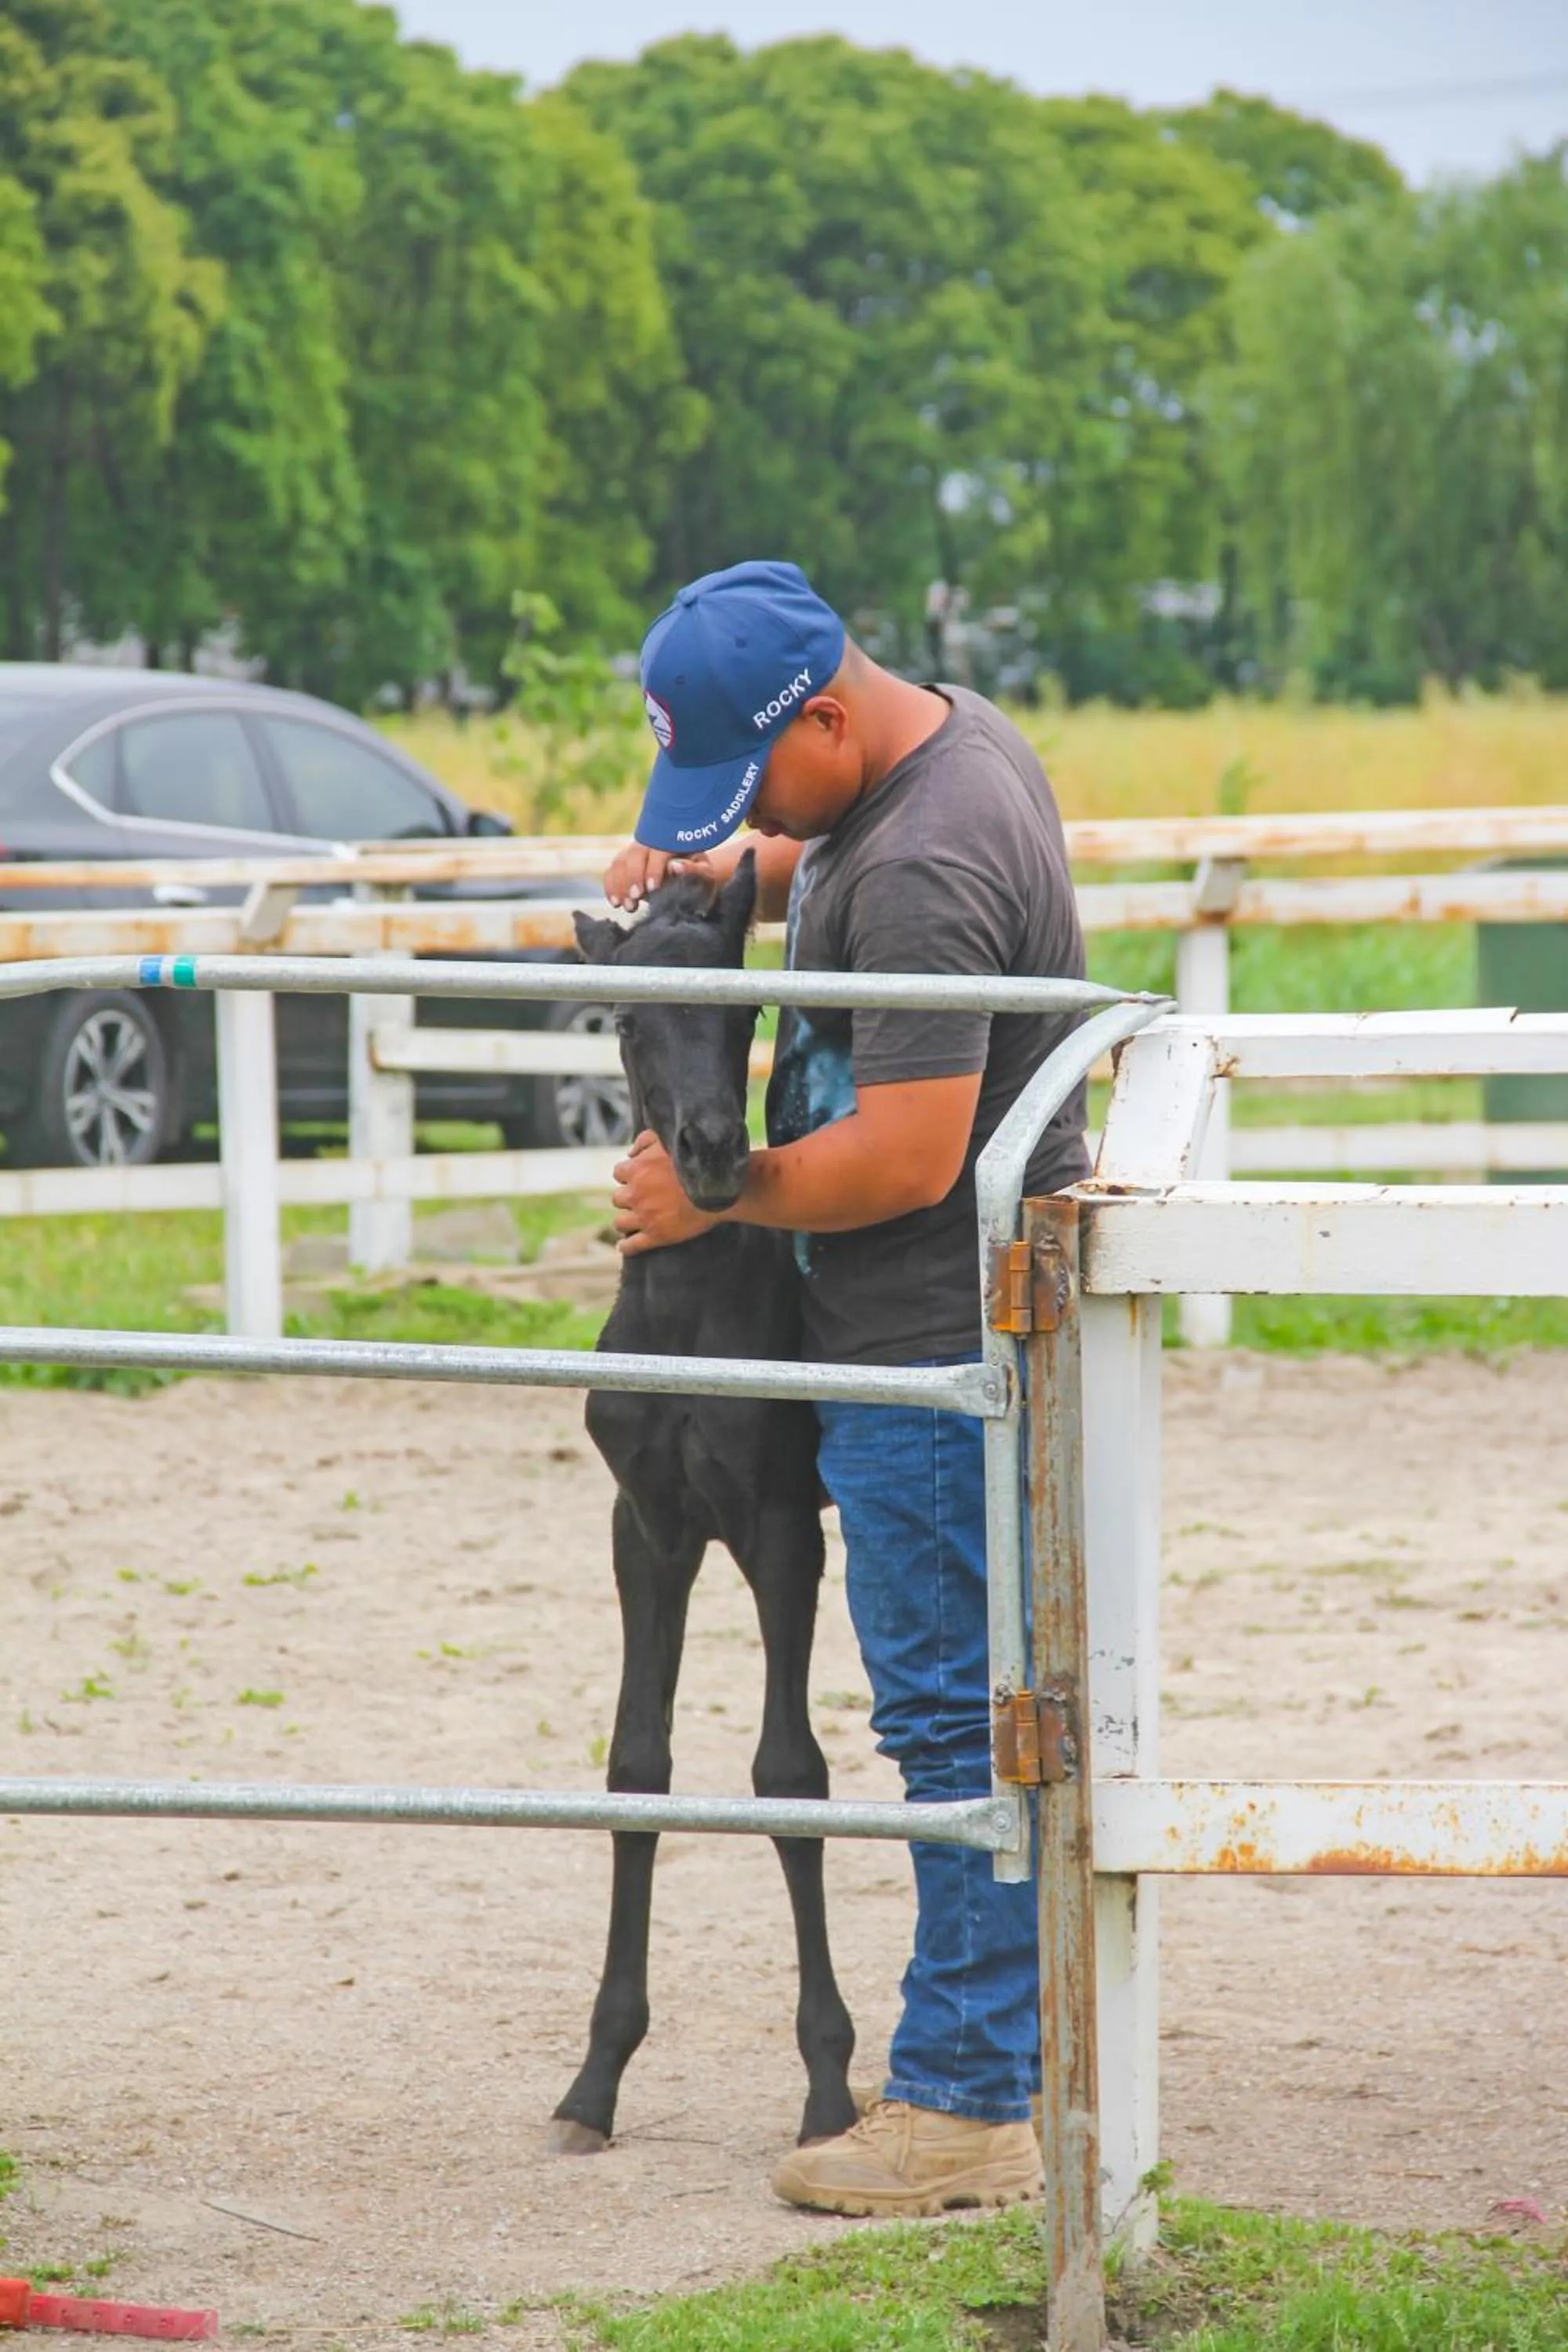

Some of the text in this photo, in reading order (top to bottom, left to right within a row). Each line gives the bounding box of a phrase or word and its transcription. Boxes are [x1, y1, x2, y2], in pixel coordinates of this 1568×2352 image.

[753, 668, 812, 729] ROCKY
[677, 763, 759, 841] ROCKY SADDLERY
